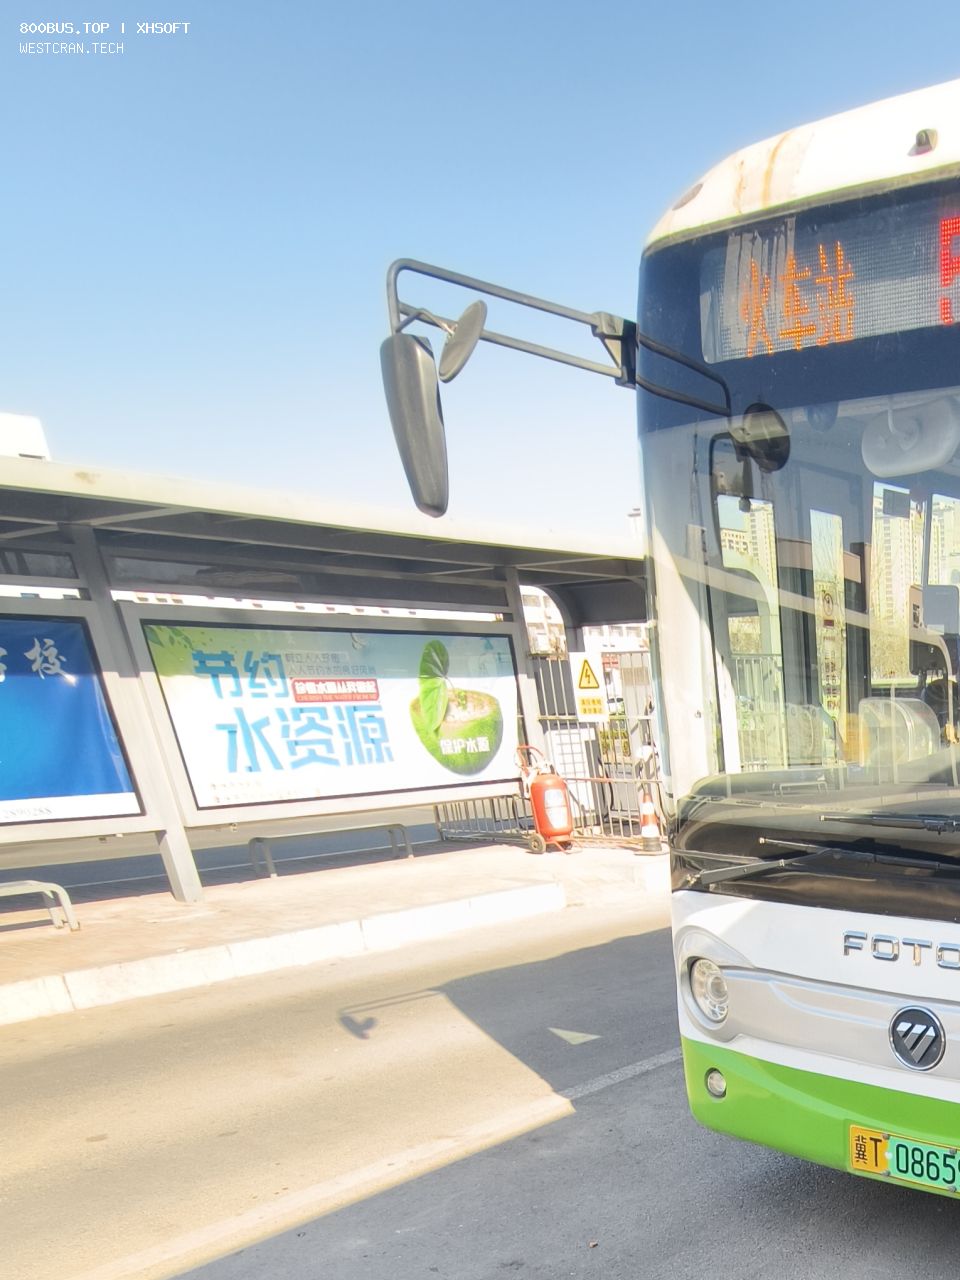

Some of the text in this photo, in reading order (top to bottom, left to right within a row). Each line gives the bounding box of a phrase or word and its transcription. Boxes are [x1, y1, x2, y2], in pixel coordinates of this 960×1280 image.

[0, 637, 77, 687] 校
[192, 650, 289, 699] 节约
[213, 704, 394, 773] 水资源
